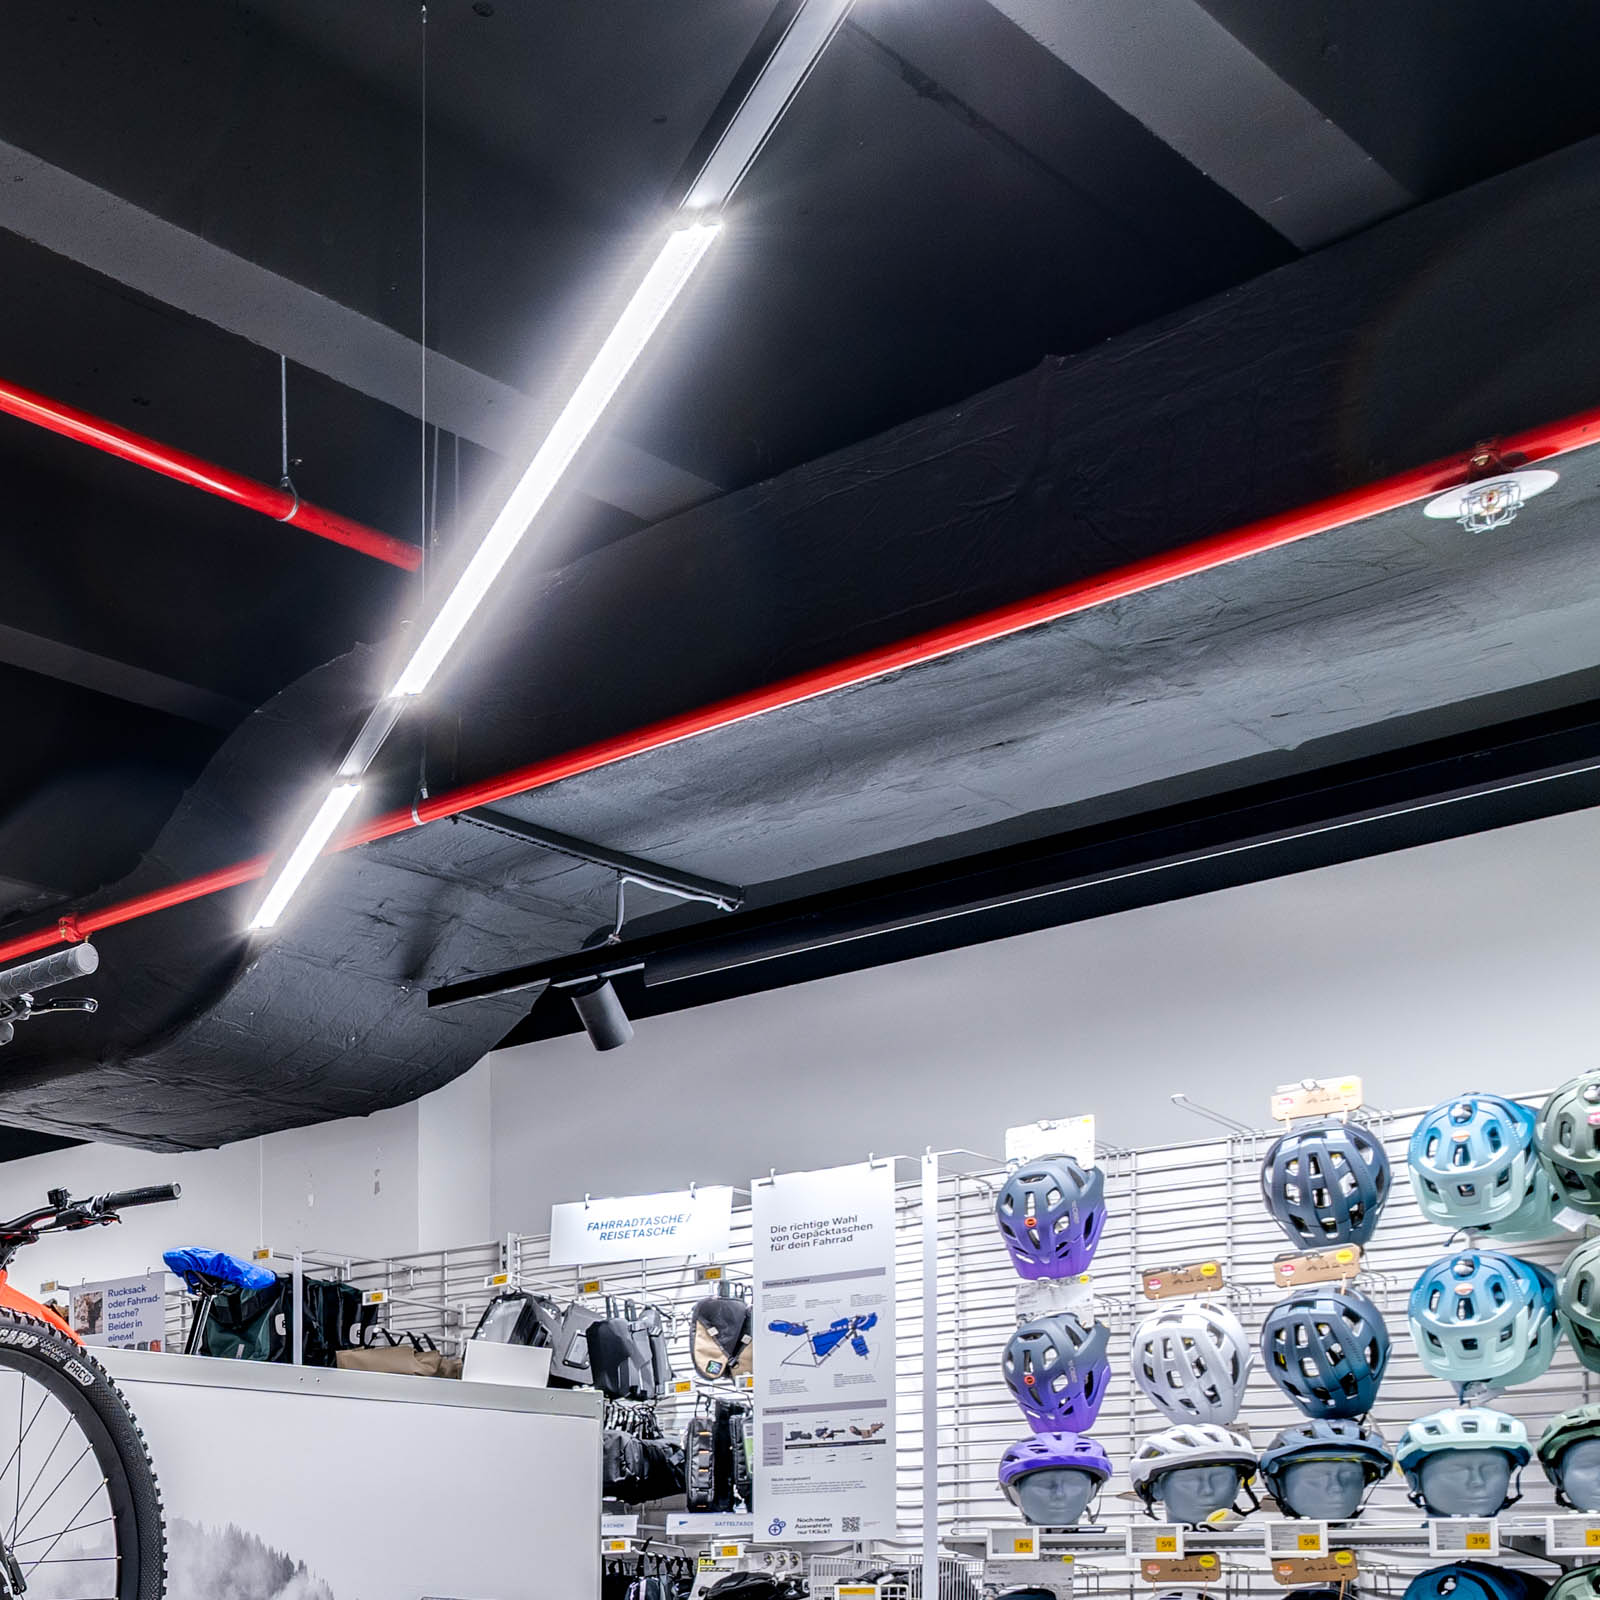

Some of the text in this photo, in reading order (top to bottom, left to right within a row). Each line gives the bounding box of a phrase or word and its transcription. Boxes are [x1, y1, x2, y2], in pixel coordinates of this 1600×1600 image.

[770, 1215, 858, 1234] Die richtige Wahl
[600, 1226, 677, 1241] REISETASCHE
[770, 1235, 853, 1252] für dein Fahrrad
[108, 1284, 146, 1297] Rucksack
[108, 1294, 160, 1309] oder Fahrrad-
[108, 1308, 139, 1320] tasche?
[108, 1320, 143, 1331] Beides in
[108, 1331, 134, 1342] einem!
